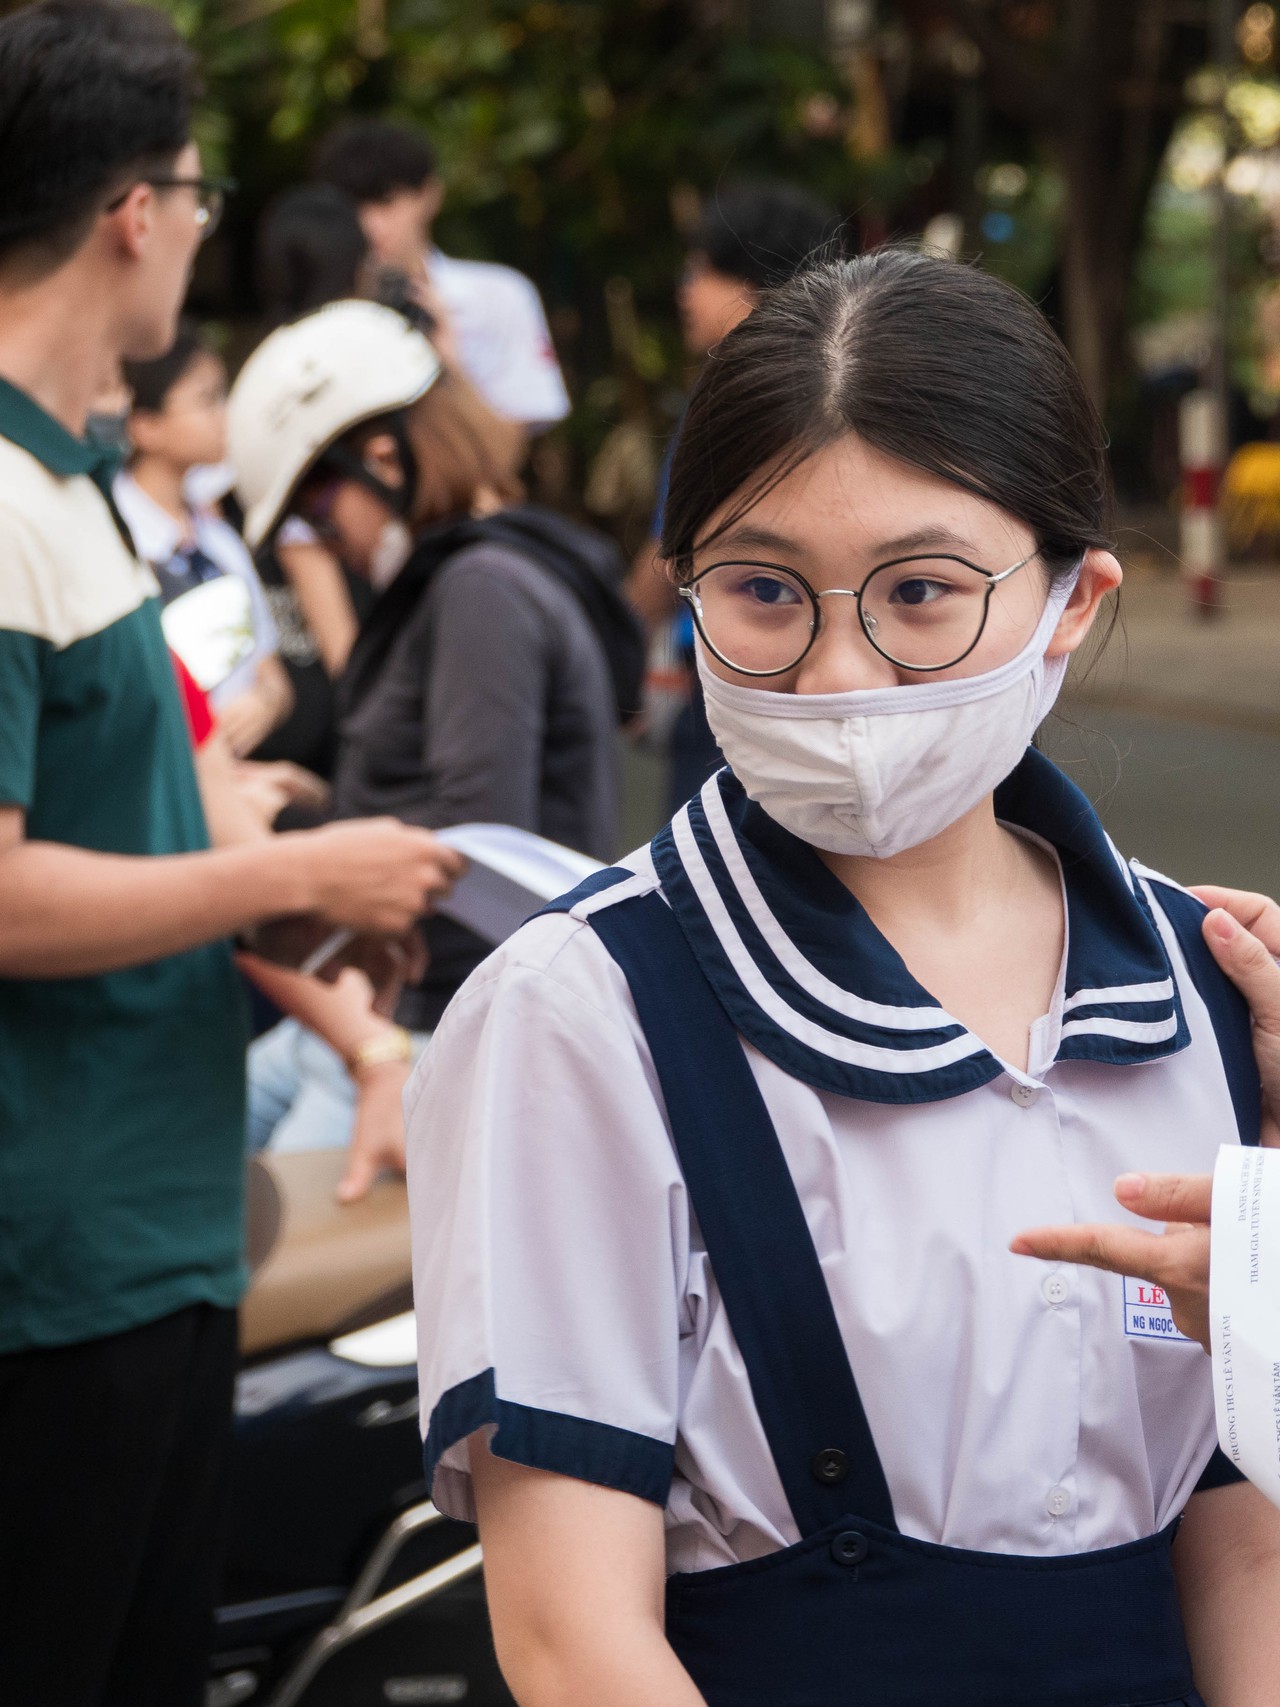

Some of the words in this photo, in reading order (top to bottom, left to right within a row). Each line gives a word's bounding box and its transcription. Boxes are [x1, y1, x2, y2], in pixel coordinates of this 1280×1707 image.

[1251, 1232, 1260, 1251] GIA
[1250, 1253, 1259, 1284] THAM
[1132, 1315, 1146, 1330] NG
[1149, 1316, 1173, 1334] NGỌC
[1223, 1341, 1232, 1365] VĂN
[1223, 1367, 1233, 1381] LÊ
[1273, 1362, 1280, 1383] TÁM
[1226, 1384, 1236, 1414] THCS
[1227, 1415, 1241, 1462] TRƯỜNG
